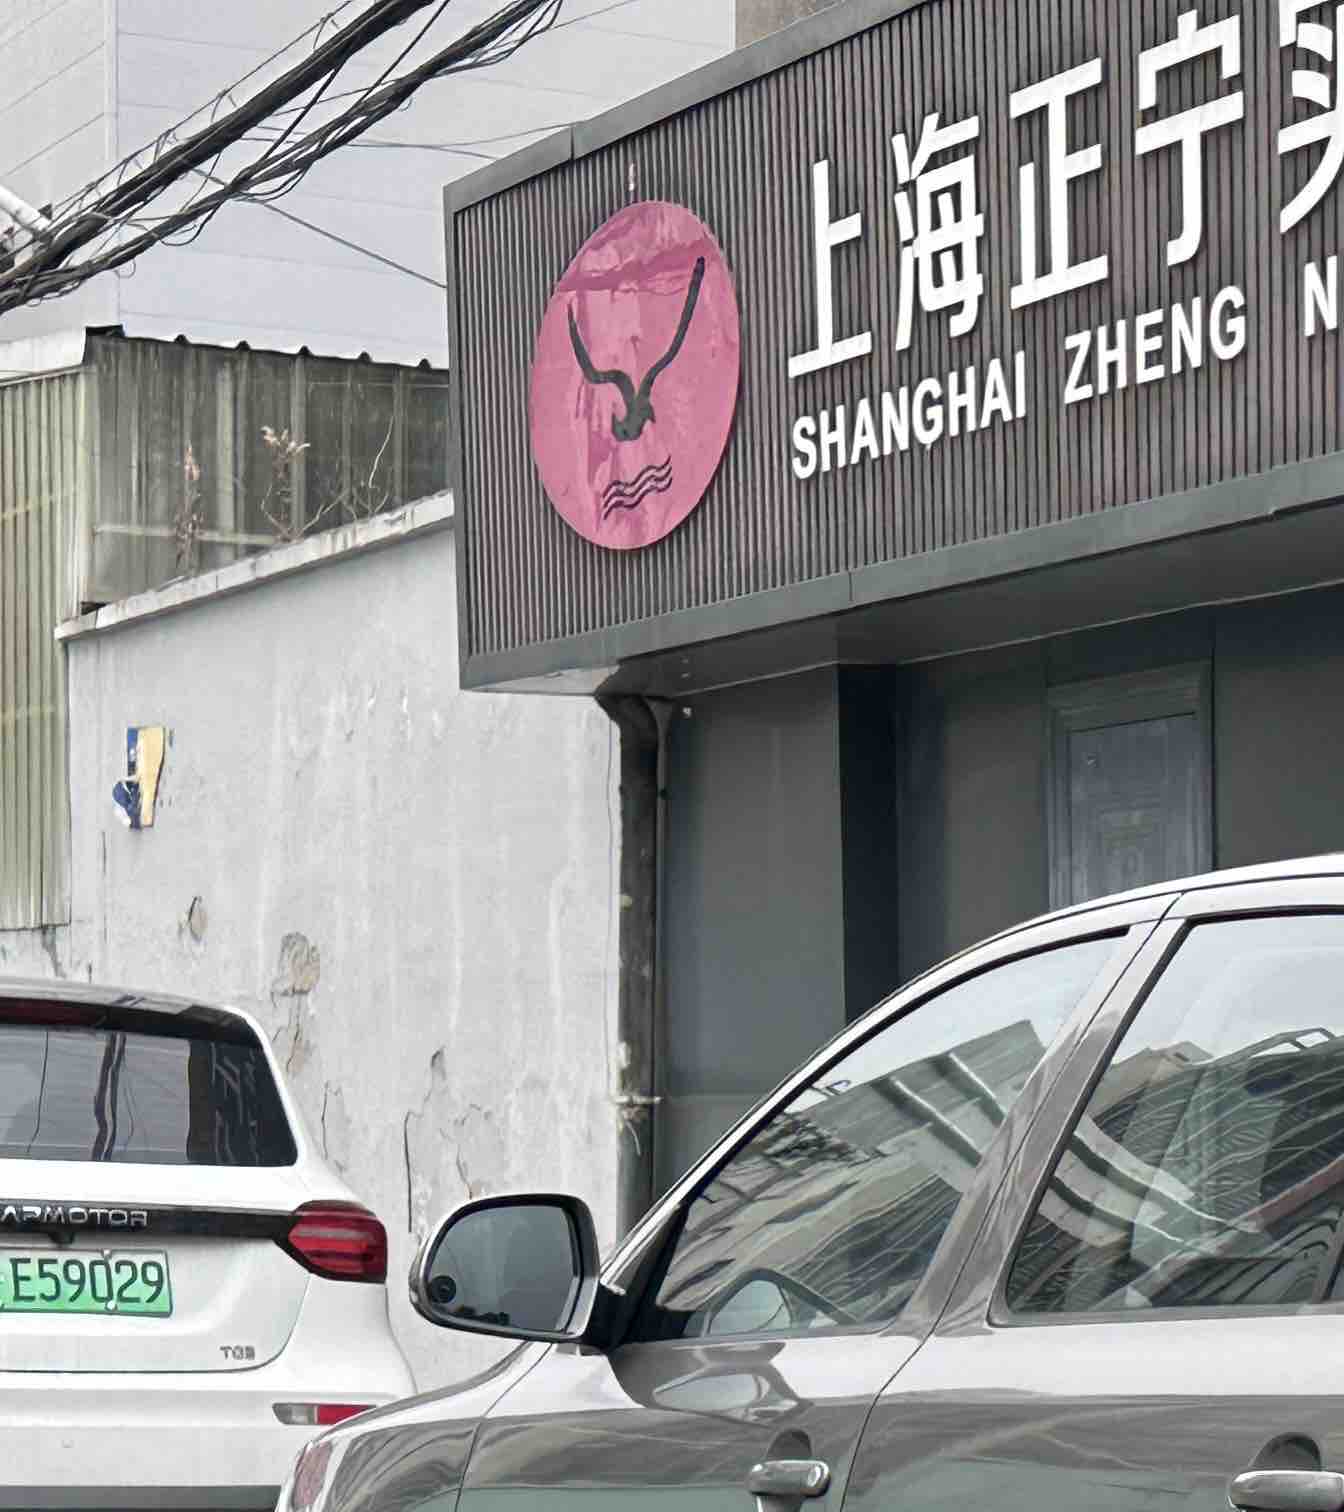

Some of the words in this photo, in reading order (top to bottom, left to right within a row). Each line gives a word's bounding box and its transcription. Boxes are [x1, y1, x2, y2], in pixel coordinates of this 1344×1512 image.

[790, 357, 1027, 480] SHANGHAI
[1063, 286, 1247, 405] ZHENG
[9, 1256, 165, 1304] E59029
